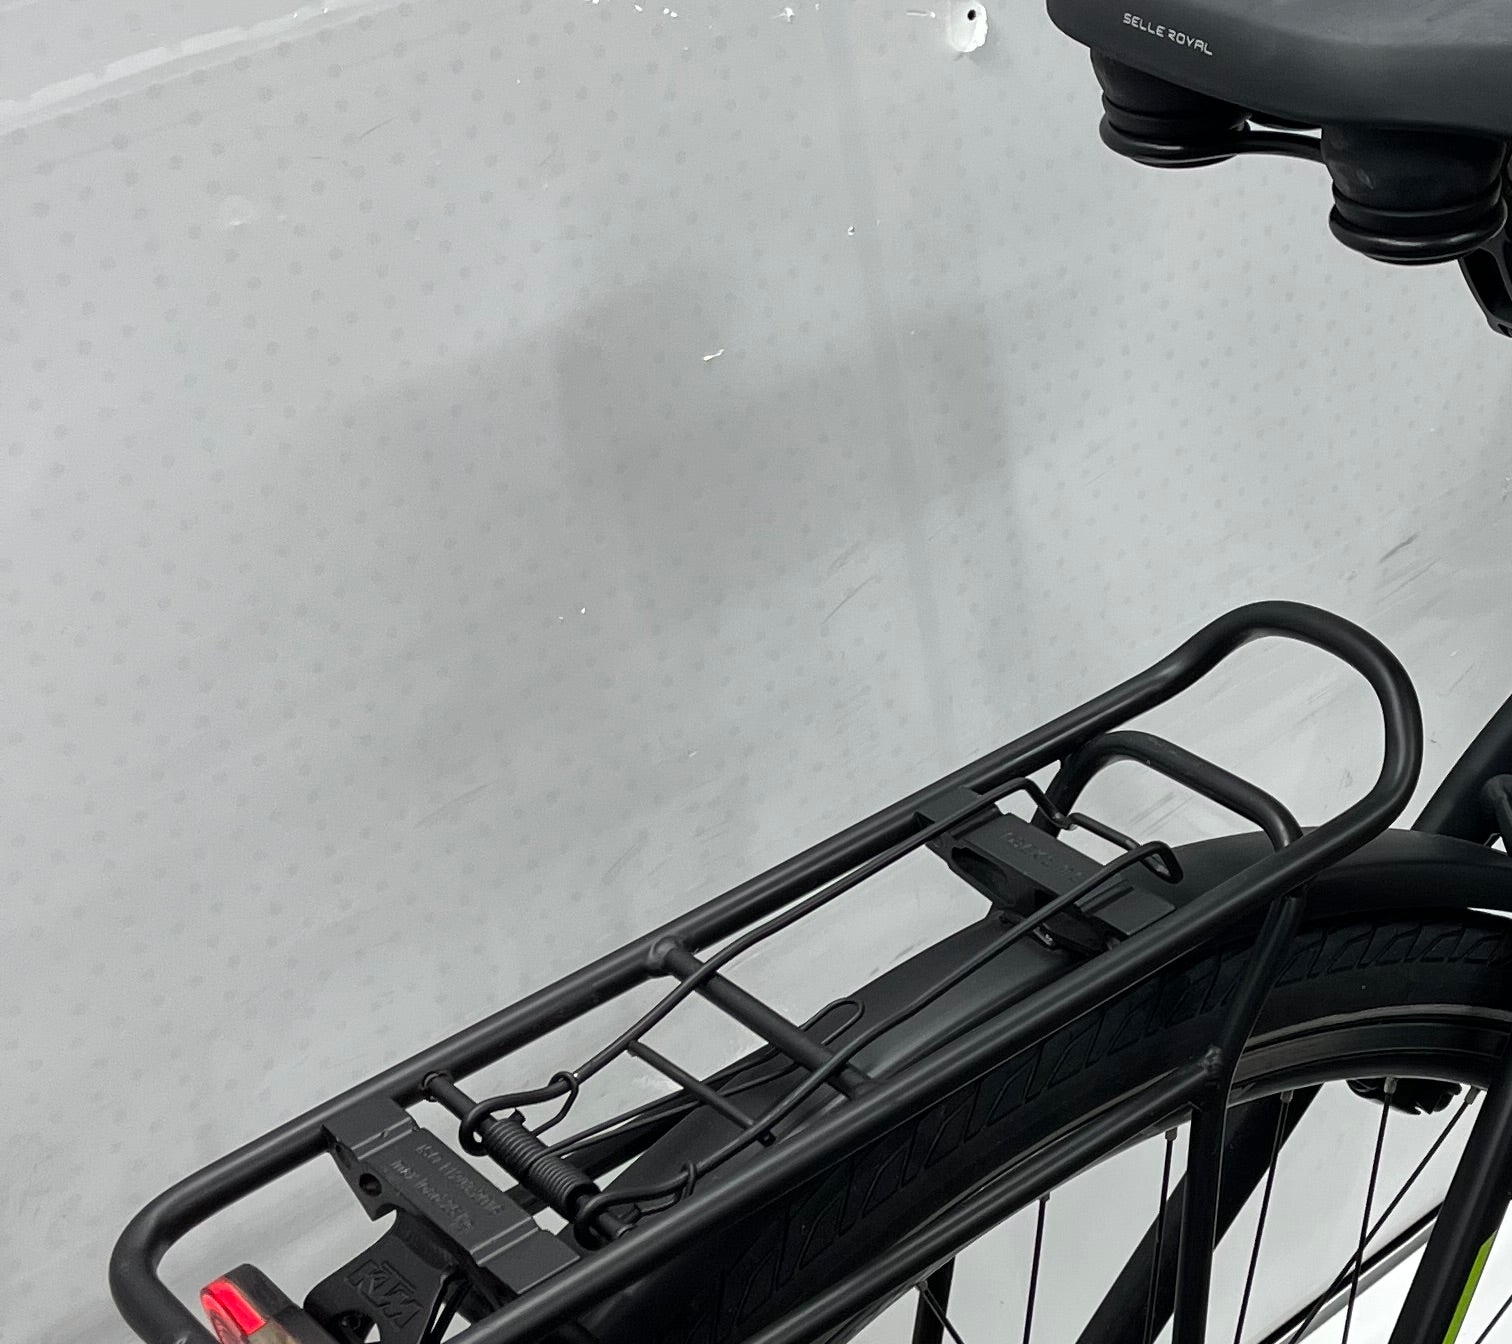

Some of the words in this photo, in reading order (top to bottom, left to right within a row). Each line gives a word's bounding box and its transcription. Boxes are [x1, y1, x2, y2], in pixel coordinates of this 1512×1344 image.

[1122, 12, 1166, 38] SELLE
[1167, 28, 1213, 56] ROYAL
[347, 1259, 424, 1329] KTM
